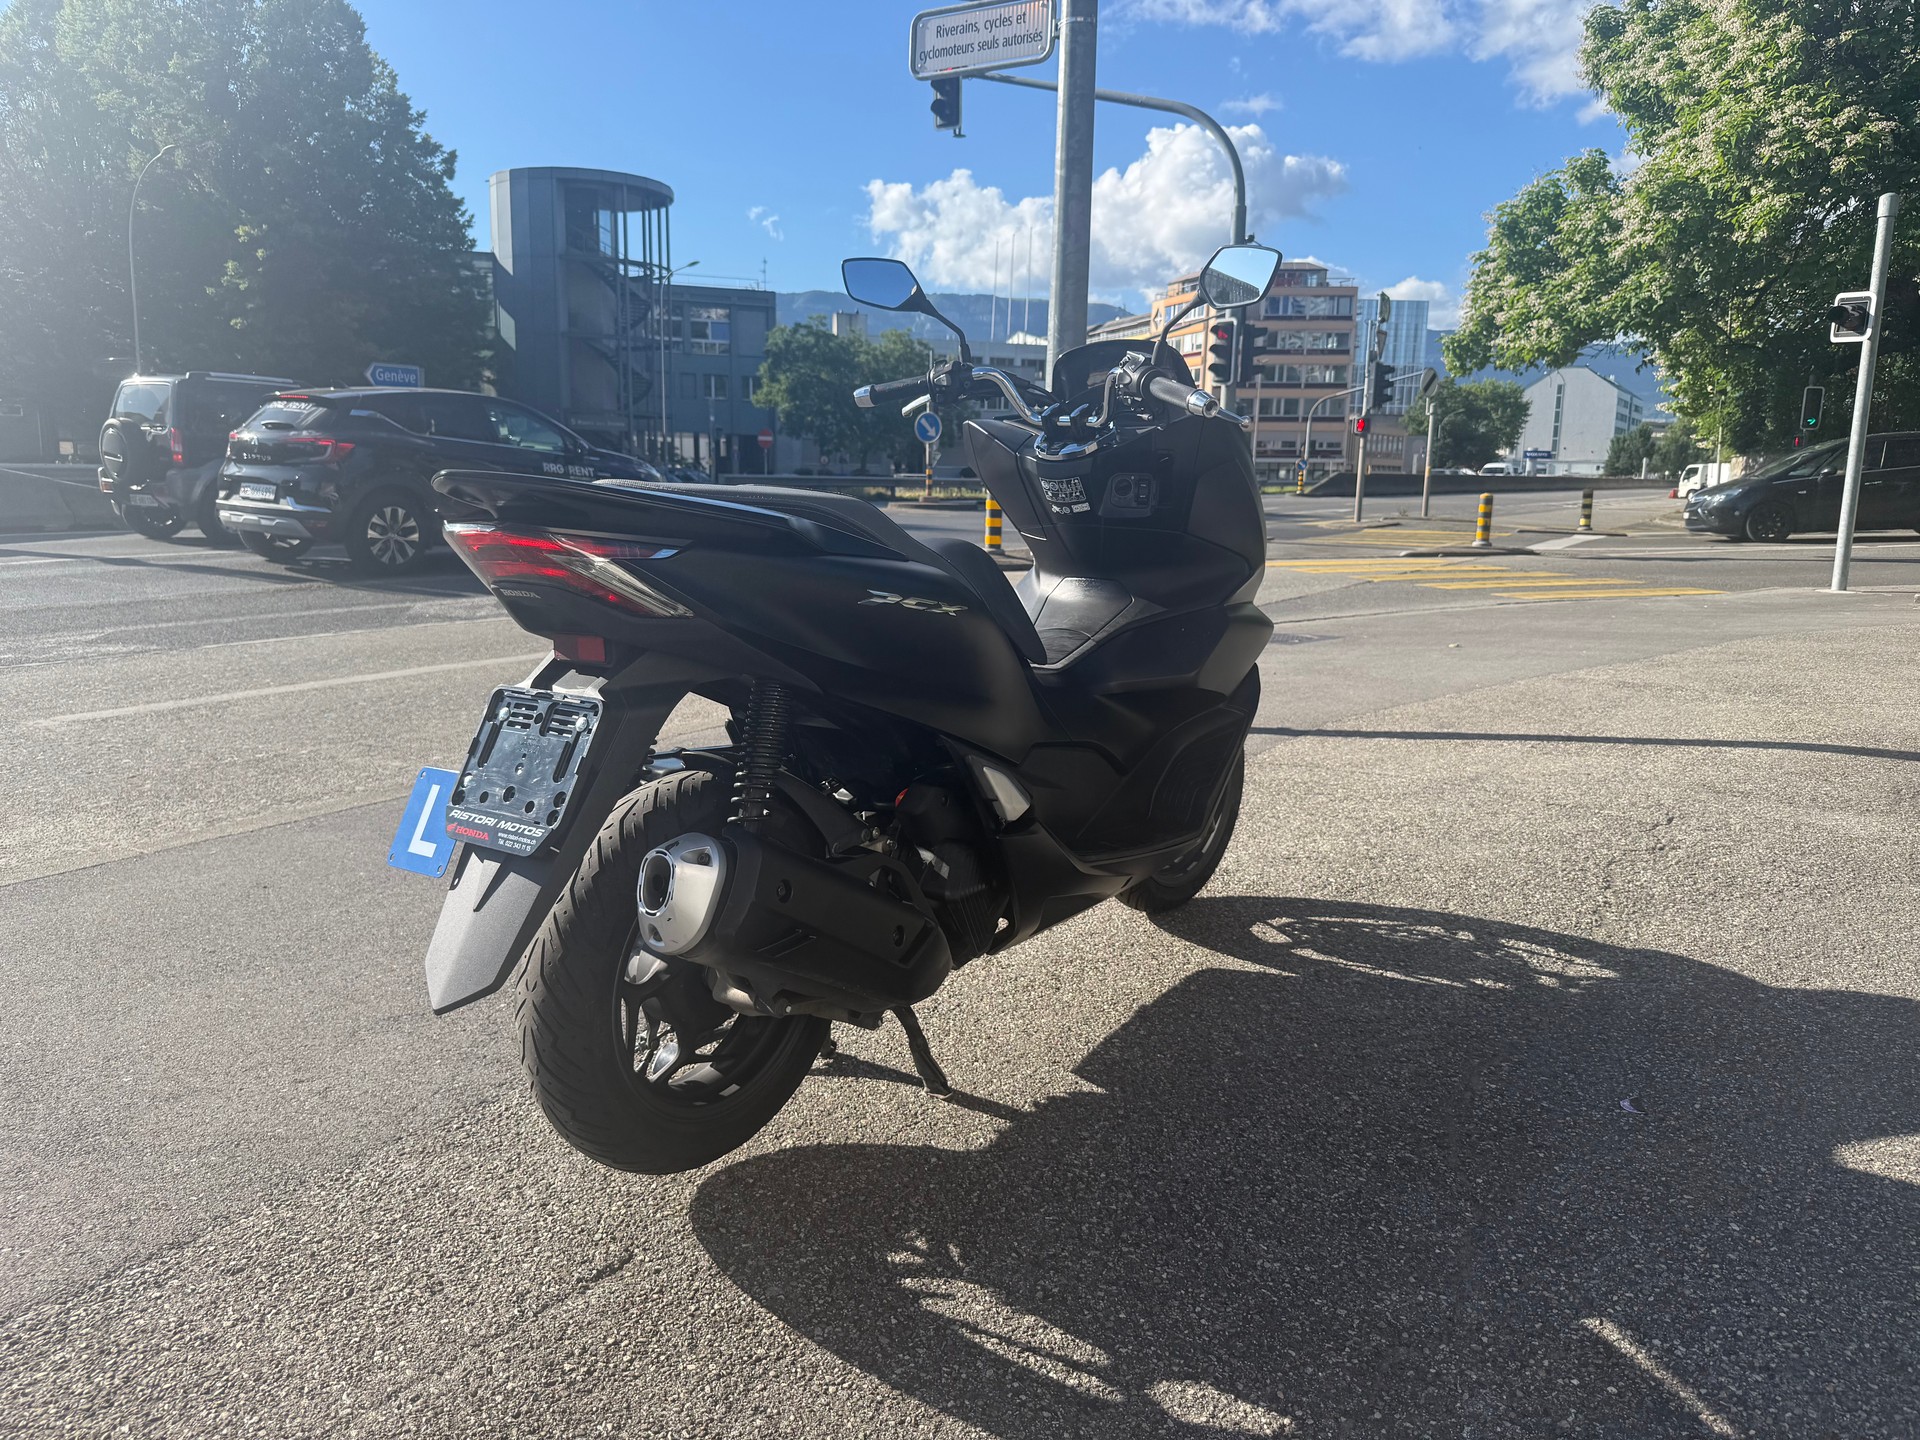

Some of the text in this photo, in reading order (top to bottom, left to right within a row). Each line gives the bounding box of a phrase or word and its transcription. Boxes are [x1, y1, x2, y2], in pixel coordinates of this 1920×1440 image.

[936, 11, 1026, 39] Riverains, cycles et
[919, 29, 1043, 64] cyclomoteurs seuls autorisés
[375, 368, 416, 384] Genève
[543, 462, 595, 477] RRG RENT
[499, 588, 542, 599] HONDA
[408, 784, 441, 858] L
[449, 809, 545, 837] RISTORI MOTOS
[455, 825, 489, 840] HONDA
